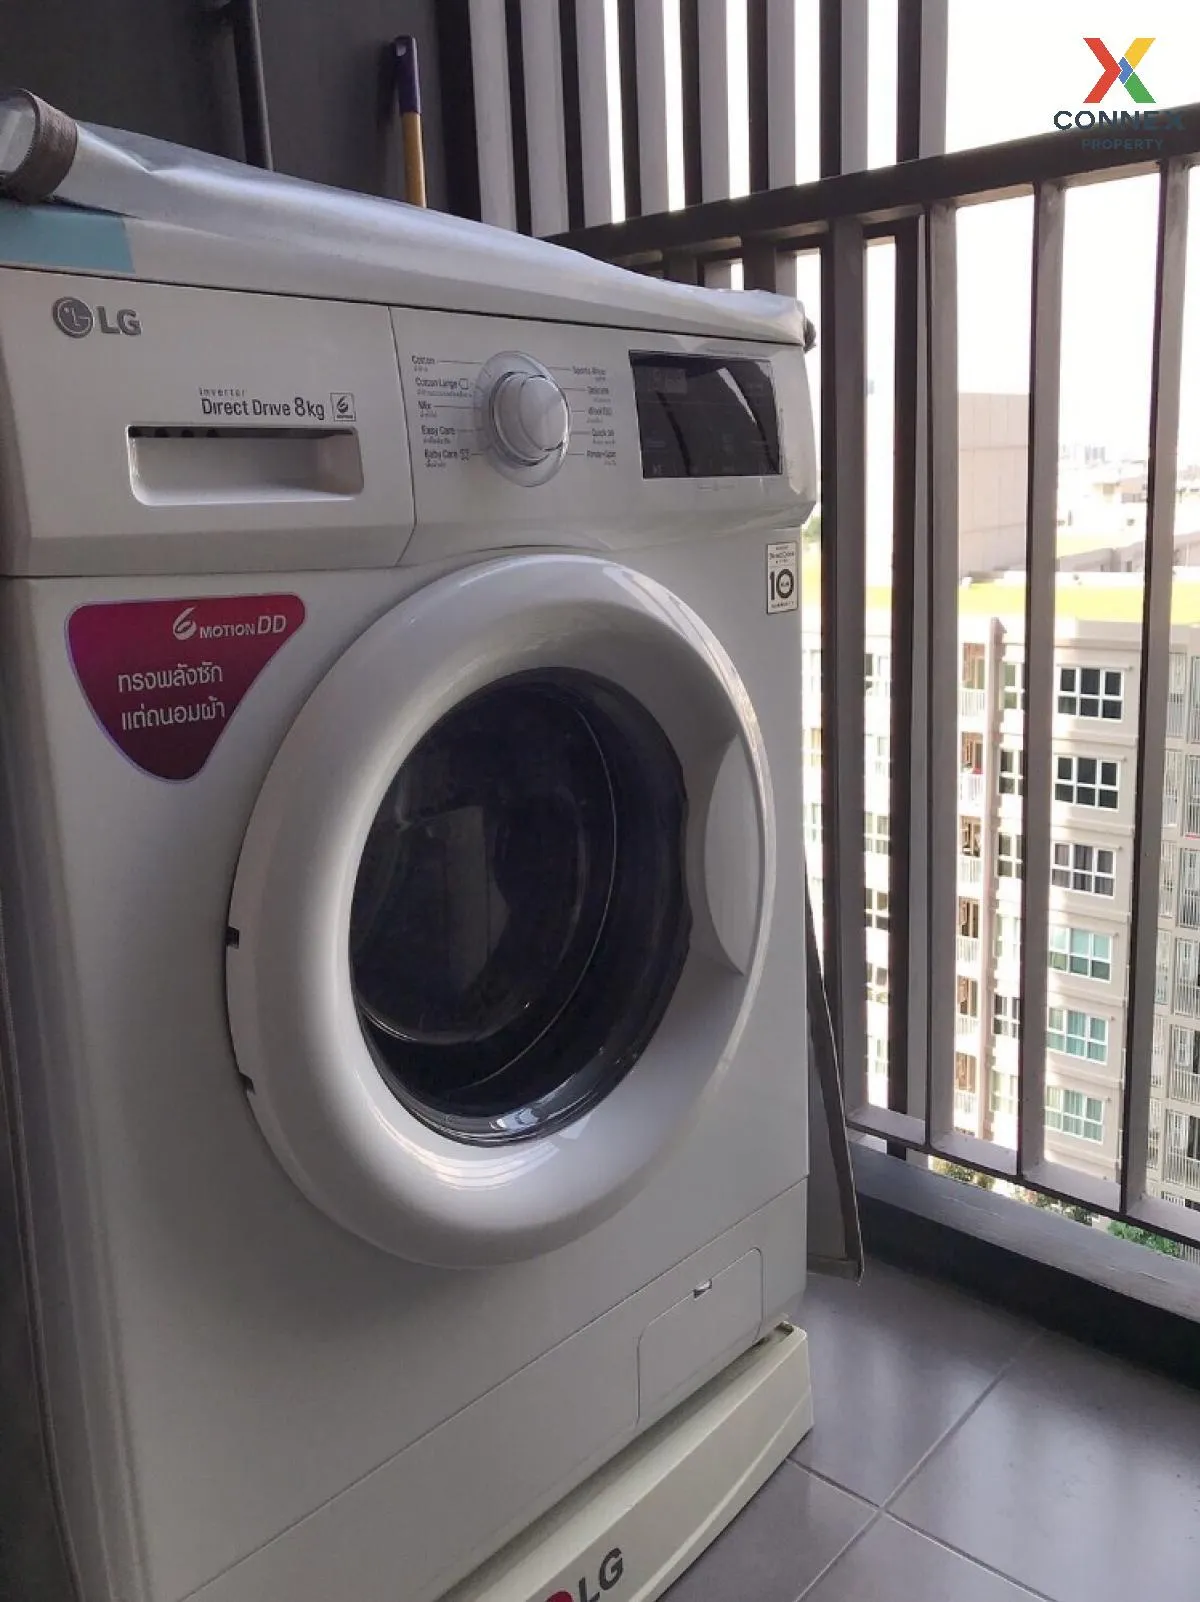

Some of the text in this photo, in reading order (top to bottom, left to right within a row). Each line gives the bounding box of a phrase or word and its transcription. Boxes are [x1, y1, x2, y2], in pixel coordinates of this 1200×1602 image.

[97, 304, 142, 336] LG
[201, 397, 250, 416] Direct
[252, 398, 291, 417] Drive
[769, 569, 794, 600] 10
[199, 624, 255, 638] MOTION
[257, 615, 286, 633] DD
[118, 660, 223, 693] ทรงพลังซัก
[121, 694, 225, 731] แต่ถนอมผ้า
[579, 1548, 623, 1602] LG
